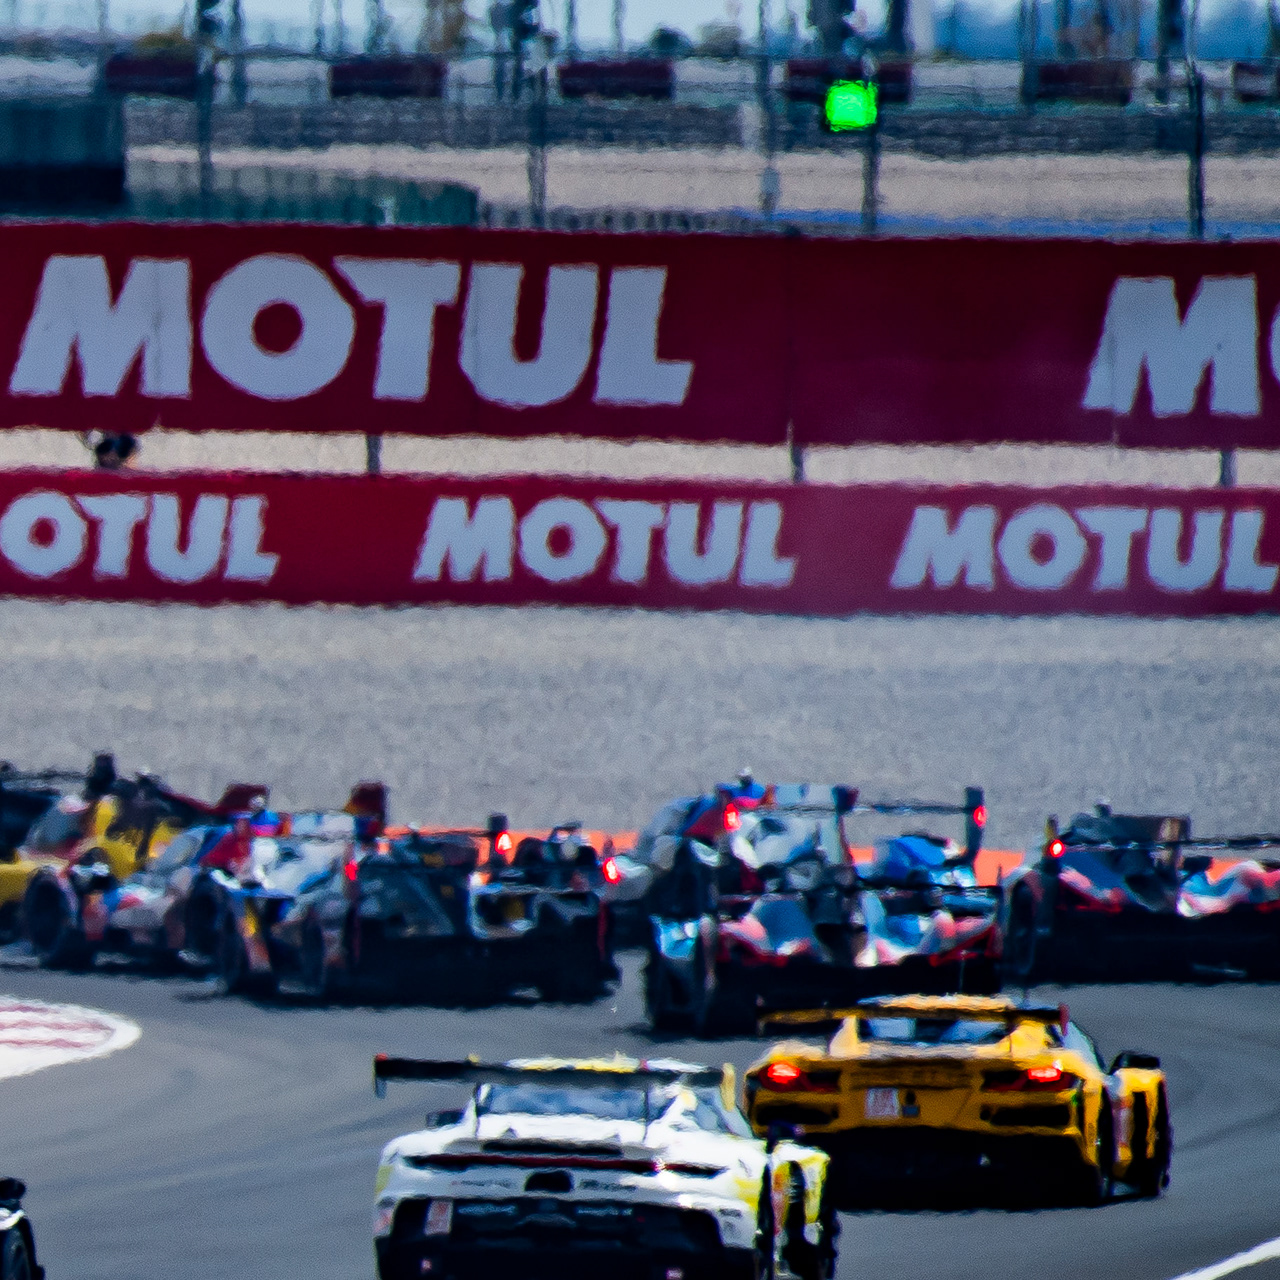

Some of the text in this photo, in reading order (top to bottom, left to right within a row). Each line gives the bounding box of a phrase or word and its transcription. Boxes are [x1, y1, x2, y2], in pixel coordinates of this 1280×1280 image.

[9, 255, 693, 406] MOTUL
[1081, 274, 1280, 418] M
[413, 496, 797, 588] MOTUL
[890, 502, 1280, 592] MOTUL
